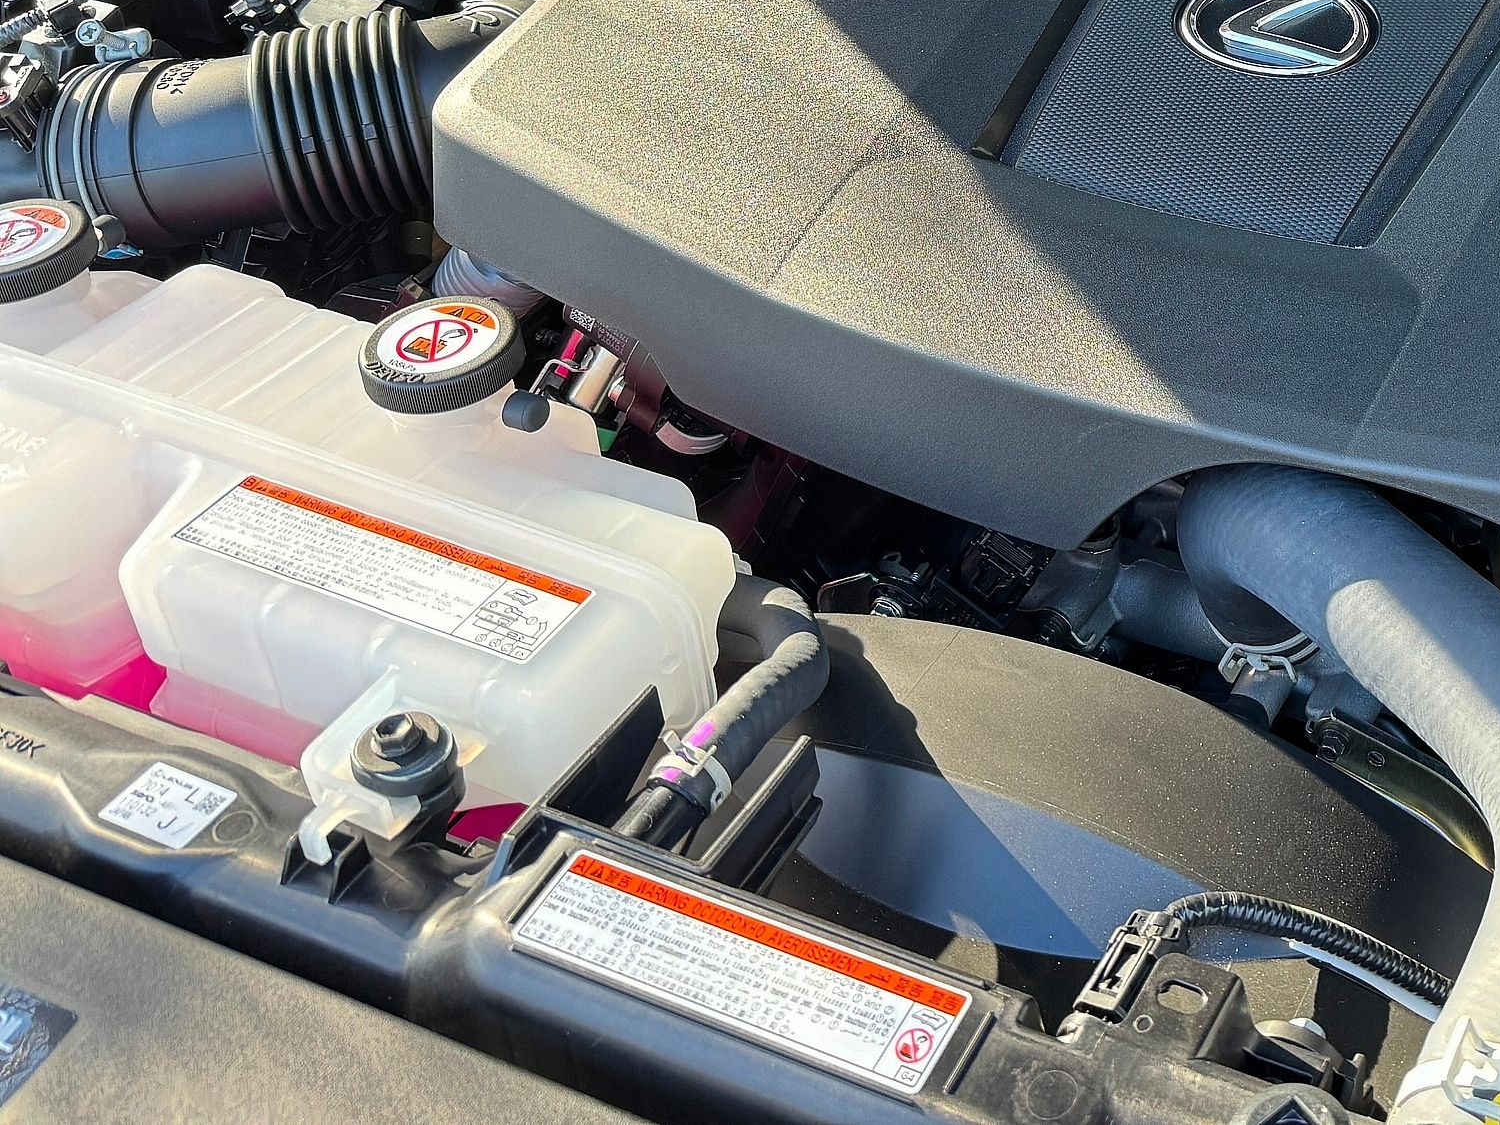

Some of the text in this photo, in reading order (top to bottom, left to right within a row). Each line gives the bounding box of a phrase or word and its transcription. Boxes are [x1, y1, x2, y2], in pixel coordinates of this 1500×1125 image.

[365, 361, 427, 383] DENSO
[290, 493, 340, 515] WARNING
[406, 533, 488, 566] AVERTISSEMENT
[572, 859, 586, 873] A
[633, 880, 691, 910] WARNING
[767, 929, 863, 974] AVERTISSEMENT
[899, 1070, 915, 1082] G4
